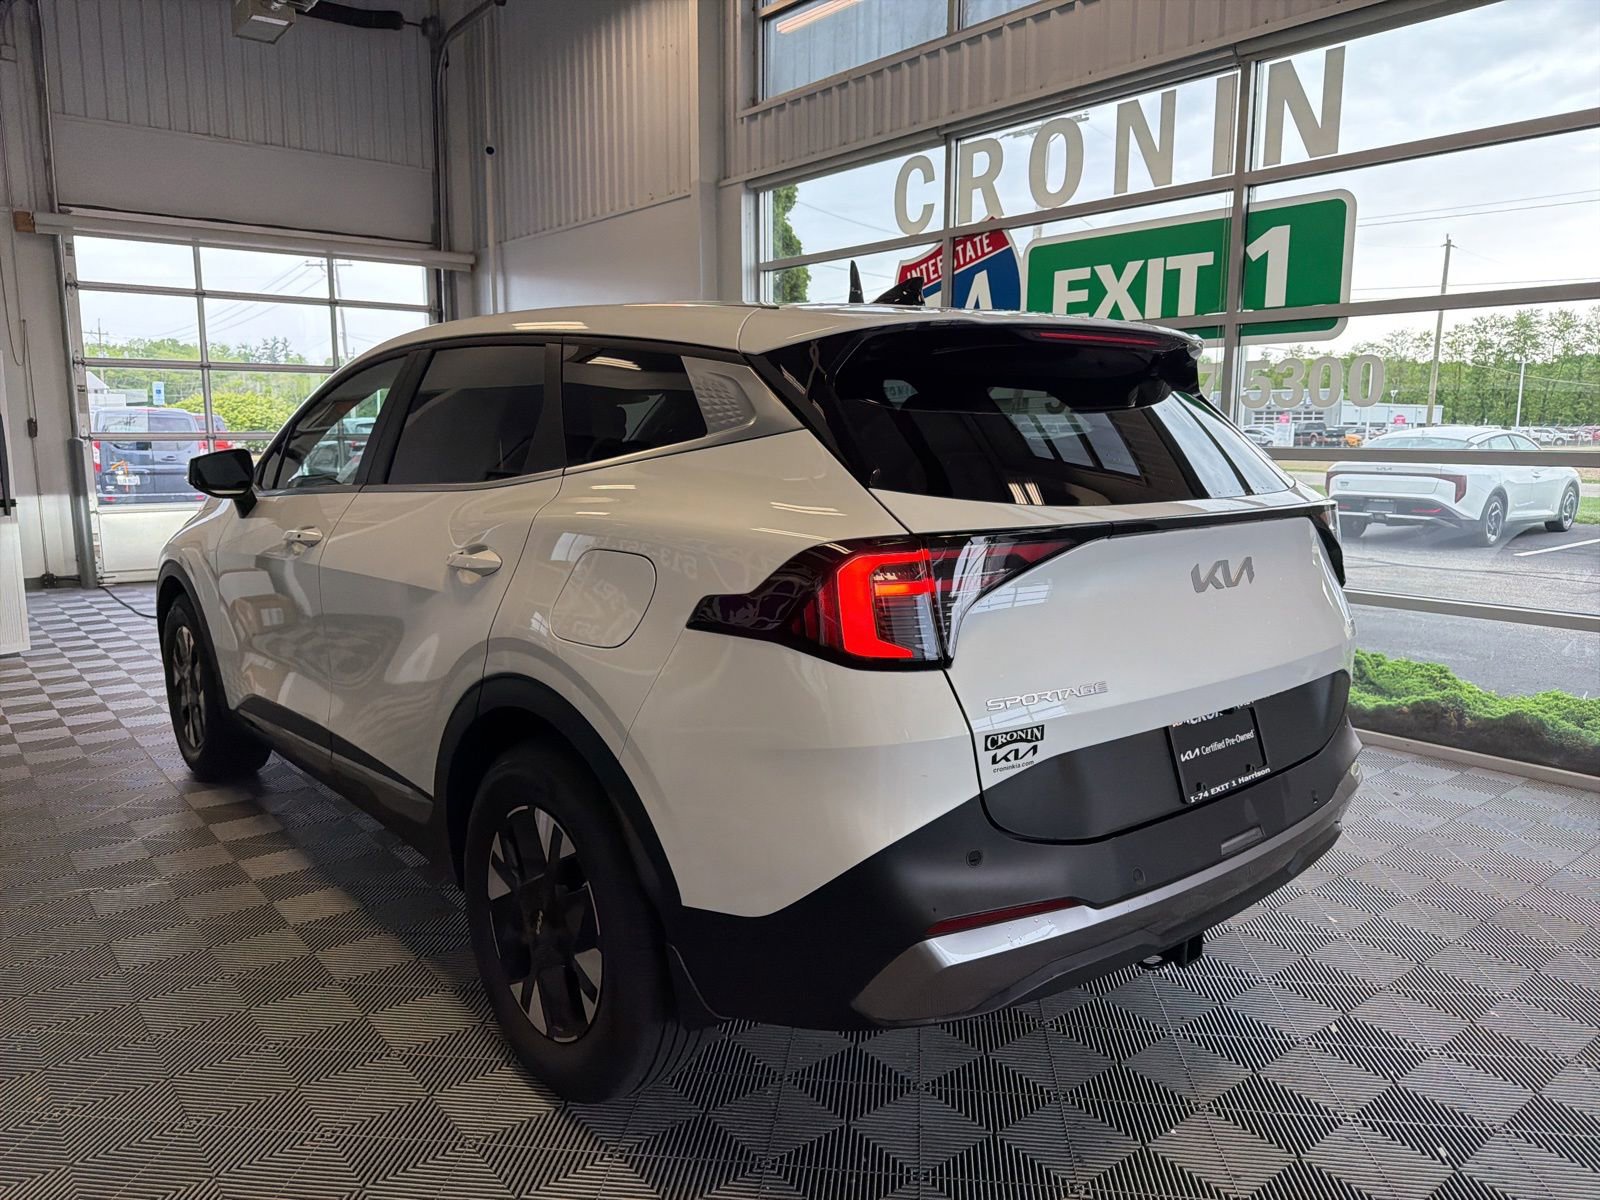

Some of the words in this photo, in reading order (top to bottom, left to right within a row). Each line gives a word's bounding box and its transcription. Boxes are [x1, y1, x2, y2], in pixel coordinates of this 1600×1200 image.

[894, 46, 1346, 235] CRONIN
[1053, 251, 1214, 320] EXIT
[1246, 225, 1291, 309] 1
[1241, 354, 1385, 409] 5300
[1190, 556, 1255, 593] KIA
[986, 681, 1108, 711] SPORTAGE
[986, 726, 1043, 750] CRONIN
[991, 744, 1038, 765] KIA
[1181, 748, 1200, 762] KIA
[1201, 739, 1226, 755] Certified
[1225, 729, 1255, 747] Pre-Owned
[993, 760, 1035, 774] croninkia.com
[1190, 791, 1209, 804] I-74
[1210, 782, 1230, 795] EXIT
[1231, 780, 1237, 788] 1
[1238, 767, 1271, 784] Harrison
